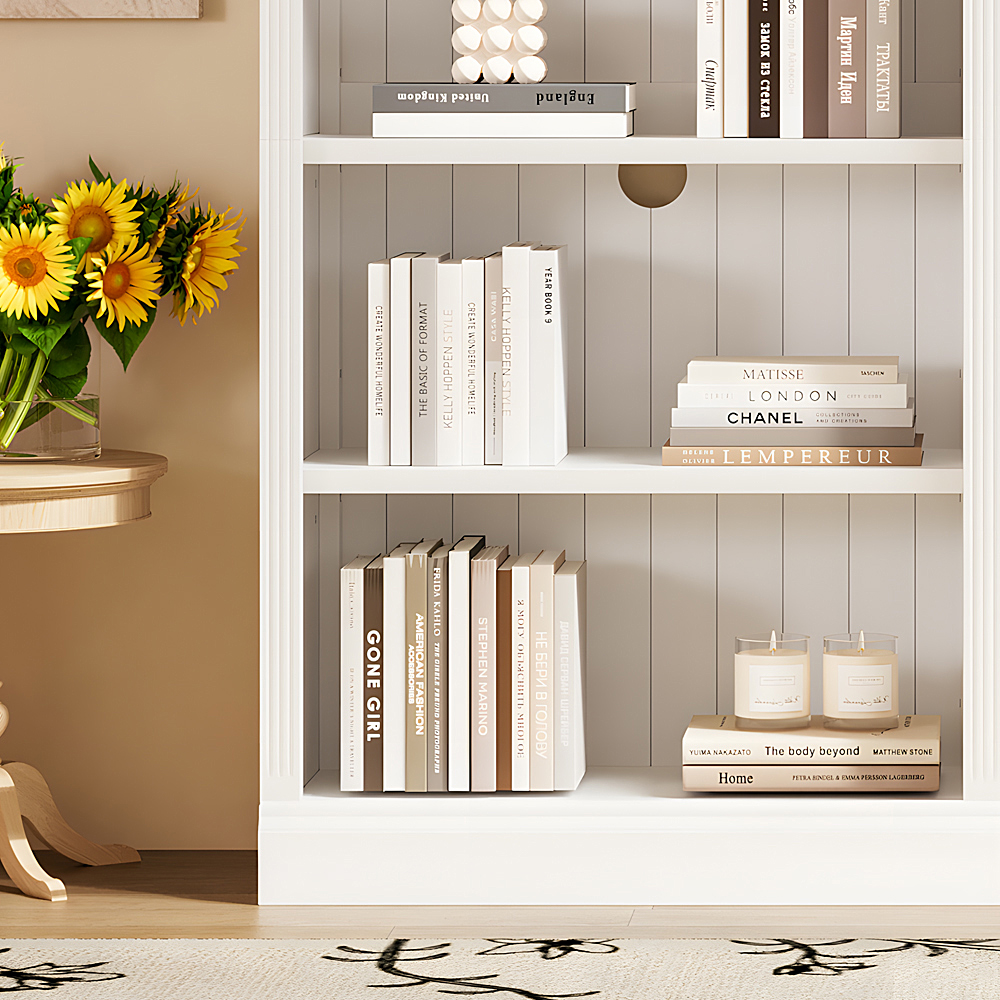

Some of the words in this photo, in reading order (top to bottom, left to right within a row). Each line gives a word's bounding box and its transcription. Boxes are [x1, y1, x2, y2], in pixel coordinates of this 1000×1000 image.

[837, 16, 857, 66] Мартин
[701, 60, 719, 111] Спартак
[788, 52, 796, 95] Айзексон
[837, 71, 857, 104] Иден
[876, 42, 890, 113] ТРАКТАТЫ
[397, 90, 448, 102] Kingdom
[451, 93, 489, 102] United
[536, 89, 595, 105] England
[544, 267, 552, 289] YEAR
[468, 302, 476, 329] CREATE
[502, 287, 511, 324] KELLY
[544, 292, 552, 315] BOOK
[419, 302, 428, 345] FORMAT
[443, 309, 453, 342] STYLE
[419, 349, 428, 362] OF
[443, 346, 453, 391] HOPPEN
[468, 332, 476, 377] WONDERFUL
[502, 328, 511, 376] HOPPEN
[419, 365, 428, 394] BASIC
[743, 369, 804, 380] MATISSE
[419, 399, 428, 417] THE
[443, 395, 453, 429] KELLY
[468, 379, 476, 415] HOMELIFE
[502, 380, 511, 416] STYLE
[749, 390, 837, 402] LONDON
[727, 412, 803, 424] CHANEL
[723, 449, 892, 464] LEMPEREUR
[433, 567, 441, 598] FRIDA
[433, 601, 441, 637] KAHLO
[415, 613, 424, 678] AMERICAN
[478, 617, 488, 678] STEPHEN
[535, 632, 547, 648] НЕ
[366, 629, 381, 689] GONE
[535, 652, 547, 687] БЕРИ
[415, 681, 424, 735] FASHION
[478, 682, 488, 736] MARINO
[536, 692, 547, 700] В
[366, 697, 381, 742] GIRL
[534, 704, 547, 759] ГОЛОВУ
[765, 746, 785, 756] The
[788, 746, 815, 758] body
[819, 746, 860, 758] beyond
[718, 772, 754, 784] Home
